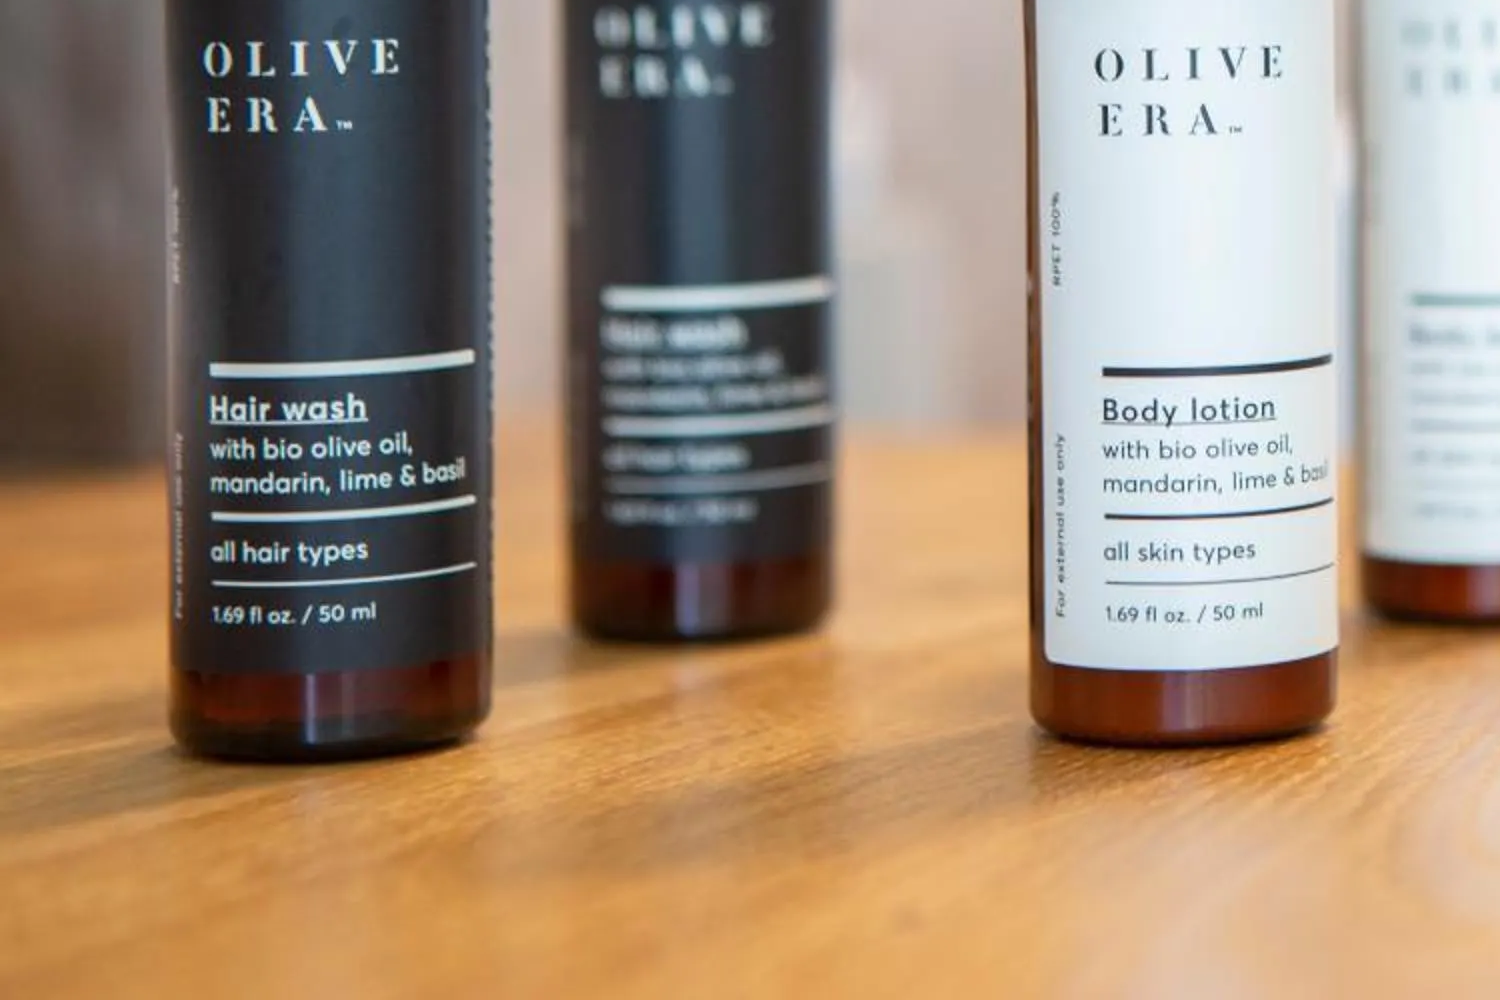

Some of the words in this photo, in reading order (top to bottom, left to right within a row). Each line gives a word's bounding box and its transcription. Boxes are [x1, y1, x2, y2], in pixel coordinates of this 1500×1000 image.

[203, 38, 400, 77] OLIVE
[1094, 46, 1283, 82] OLIVE
[210, 395, 271, 422] Hair
[281, 393, 368, 423] wash
[1102, 398, 1178, 428] Body
[1191, 397, 1277, 422] lotion
[210, 437, 255, 461] with
[263, 437, 303, 461] bio
[311, 436, 371, 459] olive
[379, 430, 413, 456] oil,
[1054, 433, 1066, 471] only
[1102, 439, 1149, 460] with
[1159, 439, 1197, 460] bio
[1206, 437, 1259, 458] olive
[1266, 433, 1293, 455] oil,
[210, 470, 331, 496] mandarin,
[340, 469, 392, 493] lime
[400, 464, 416, 488] &
[422, 456, 465, 485] basil
[1056, 476, 1066, 506] use
[1103, 473, 1223, 495] mandarin,
[1232, 471, 1277, 492] lime
[1283, 465, 1295, 486] &
[210, 540, 235, 563] all
[243, 540, 290, 564] hair
[297, 541, 369, 567] types
[1055, 511, 1066, 584] external
[1104, 541, 1129, 562] all
[1138, 542, 1184, 562] skin
[1193, 543, 1256, 564] types
[212, 604, 245, 625] 1.69
[249, 604, 262, 624] fl
[267, 608, 296, 625] oz.
[301, 603, 313, 627] /
[319, 603, 345, 624] 50
[351, 601, 377, 621] ml
[1055, 589, 1067, 618] For
[1105, 605, 1139, 624] 1.69
[1145, 604, 1157, 623] fl
[1164, 608, 1191, 624] oz.
[1198, 604, 1207, 624] /
[1213, 604, 1235, 623] 50
[1242, 602, 1264, 621] ml
